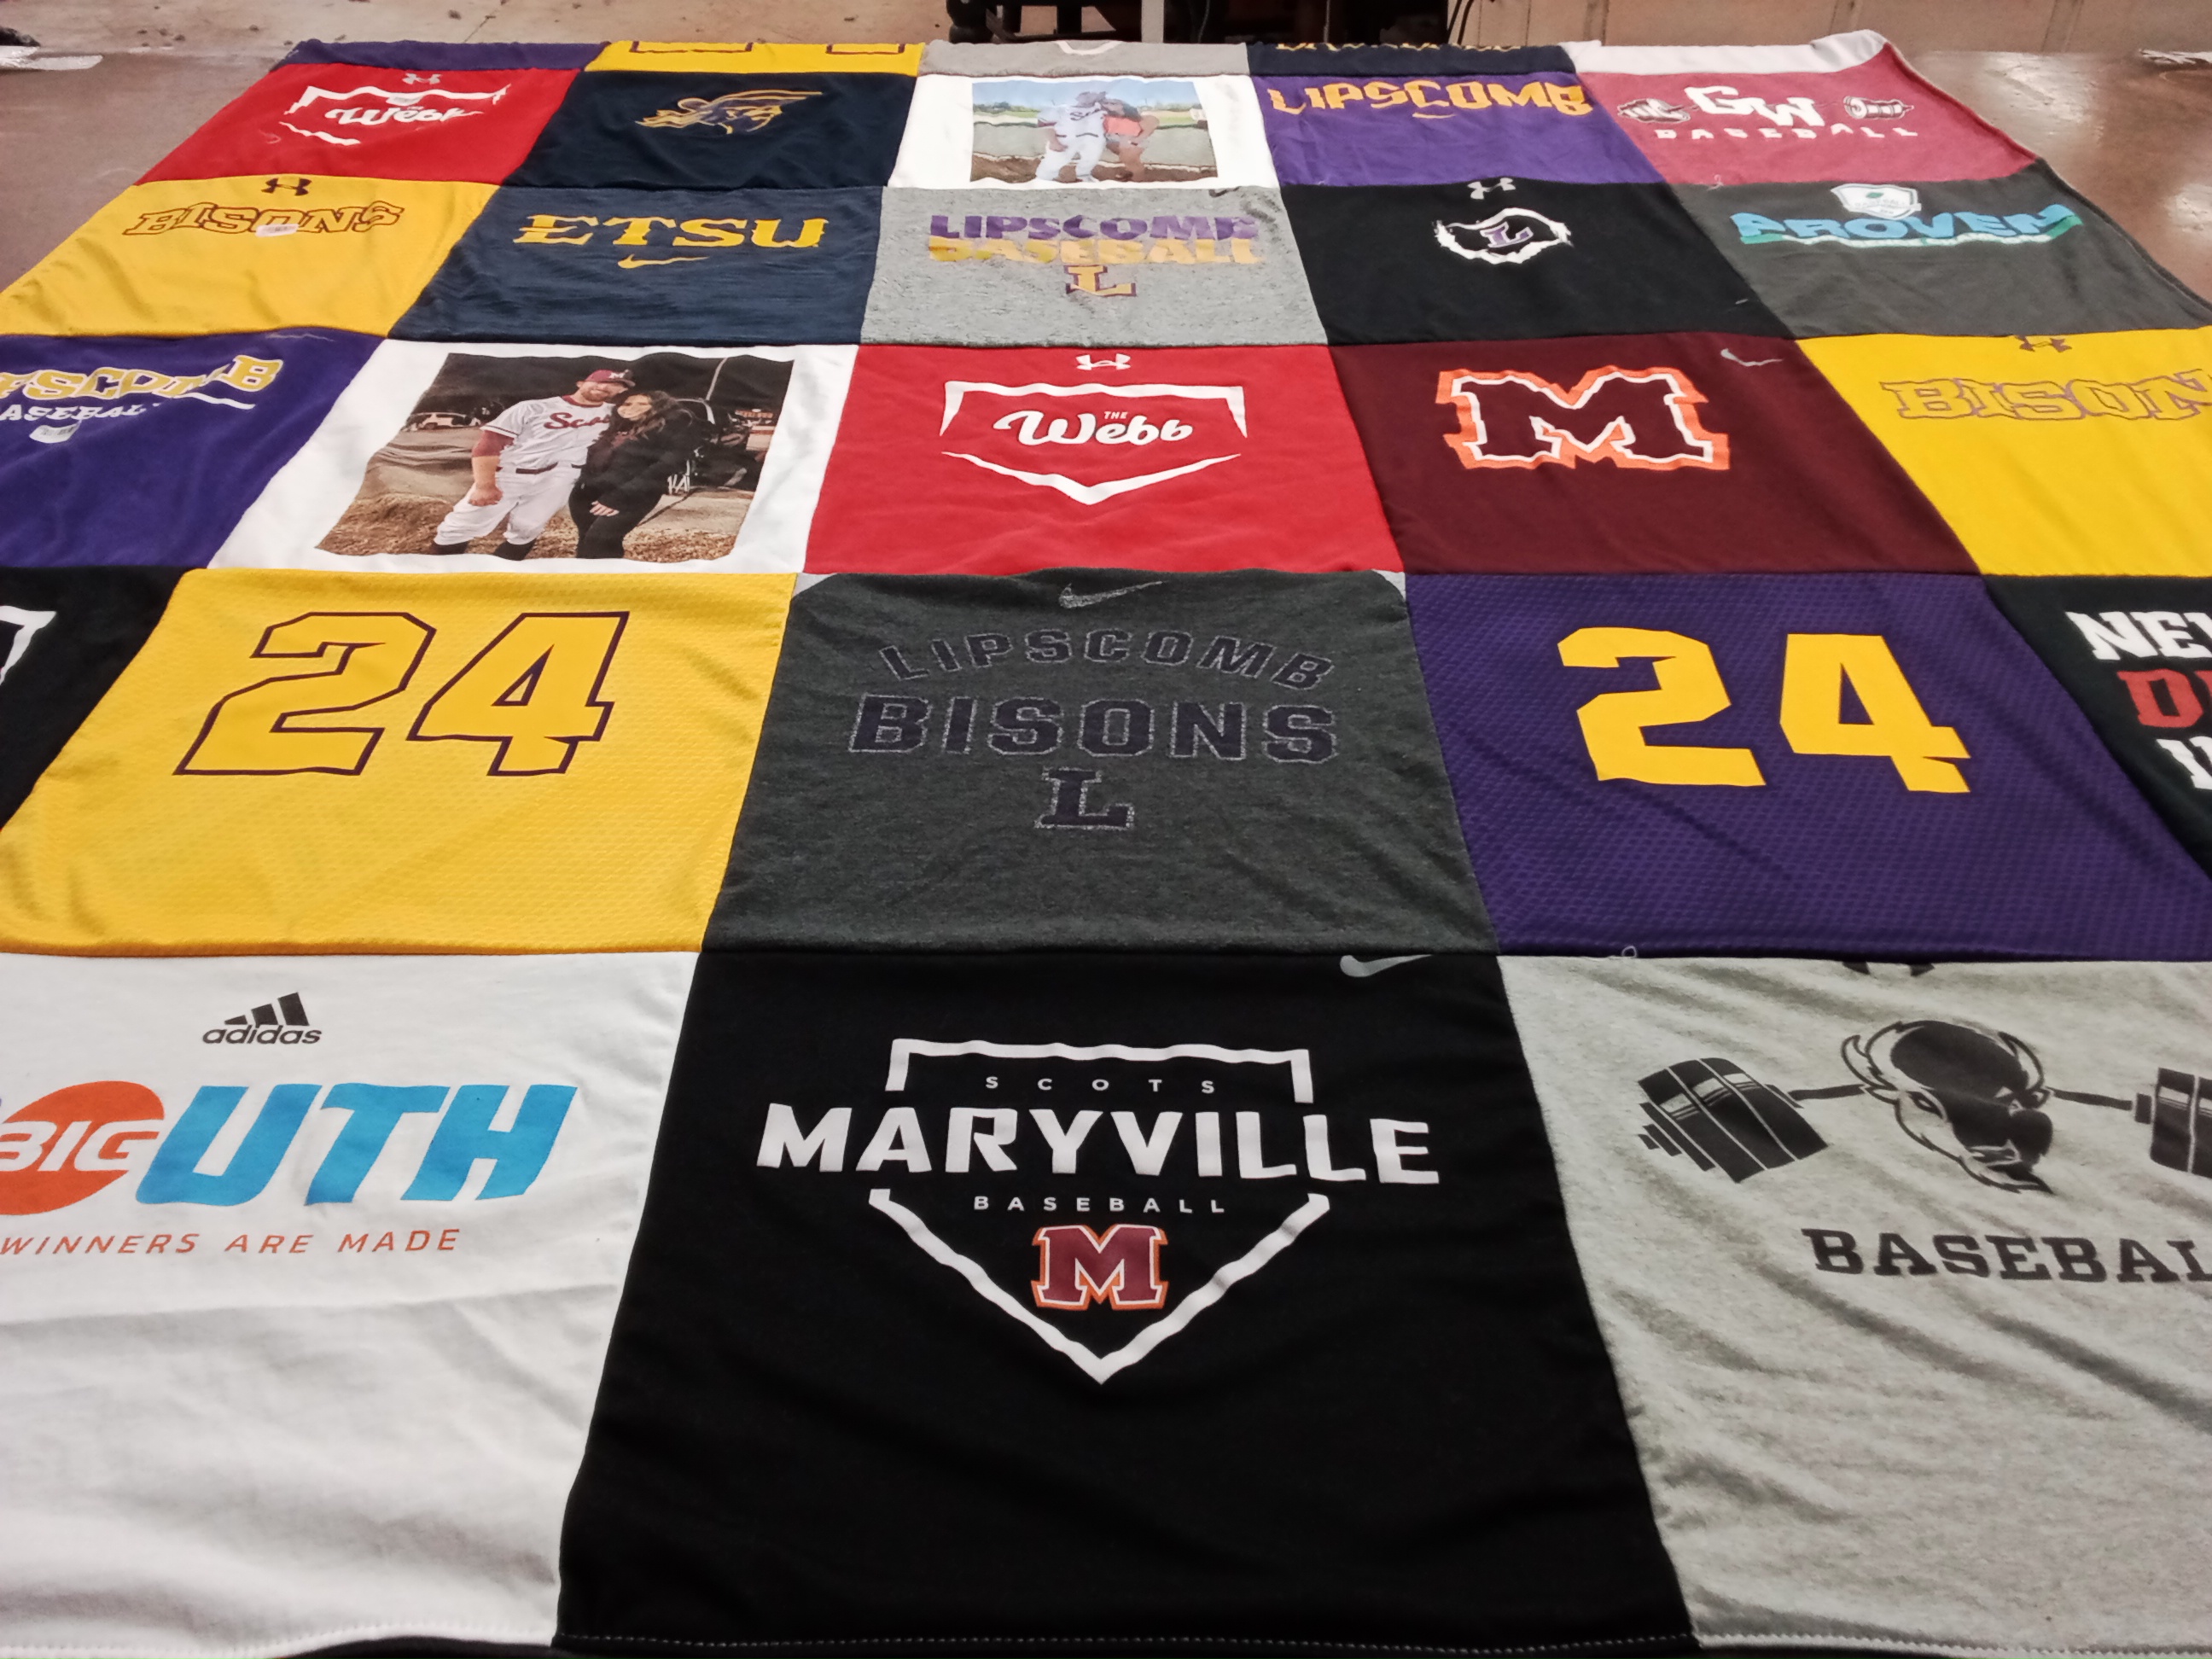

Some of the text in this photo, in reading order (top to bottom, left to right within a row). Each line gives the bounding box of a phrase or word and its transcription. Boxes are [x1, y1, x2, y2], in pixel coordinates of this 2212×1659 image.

[1267, 79, 1594, 116] LIPSCOMB
[1685, 85, 1825, 126] GW
[1654, 123, 1918, 139] BASEBALL
[122, 201, 405, 236] BISONS
[512, 214, 829, 247] ETSU
[1479, 221, 1534, 247] L
[1063, 265, 1138, 297] L
[992, 410, 1193, 445] Webb
[1103, 410, 1128, 419] THE
[1435, 367, 1731, 470] M
[880, 629, 1333, 690] LIPSCOMB
[172, 612, 630, 777] 24
[1557, 627, 1970, 794] 24
[848, 692, 1340, 764] BISONS
[1033, 766, 1136, 830] L
[201, 1023, 323, 1045] adidas
[985, 1074, 1215, 1094] SCOTS
[756, 1103, 1440, 1185] MARYVILLE
[974, 1196, 1225, 1214] BASEBALL
[0, 1229, 461, 1255] WINNERS ARE MADE
[1031, 1224, 1170, 1311] M
